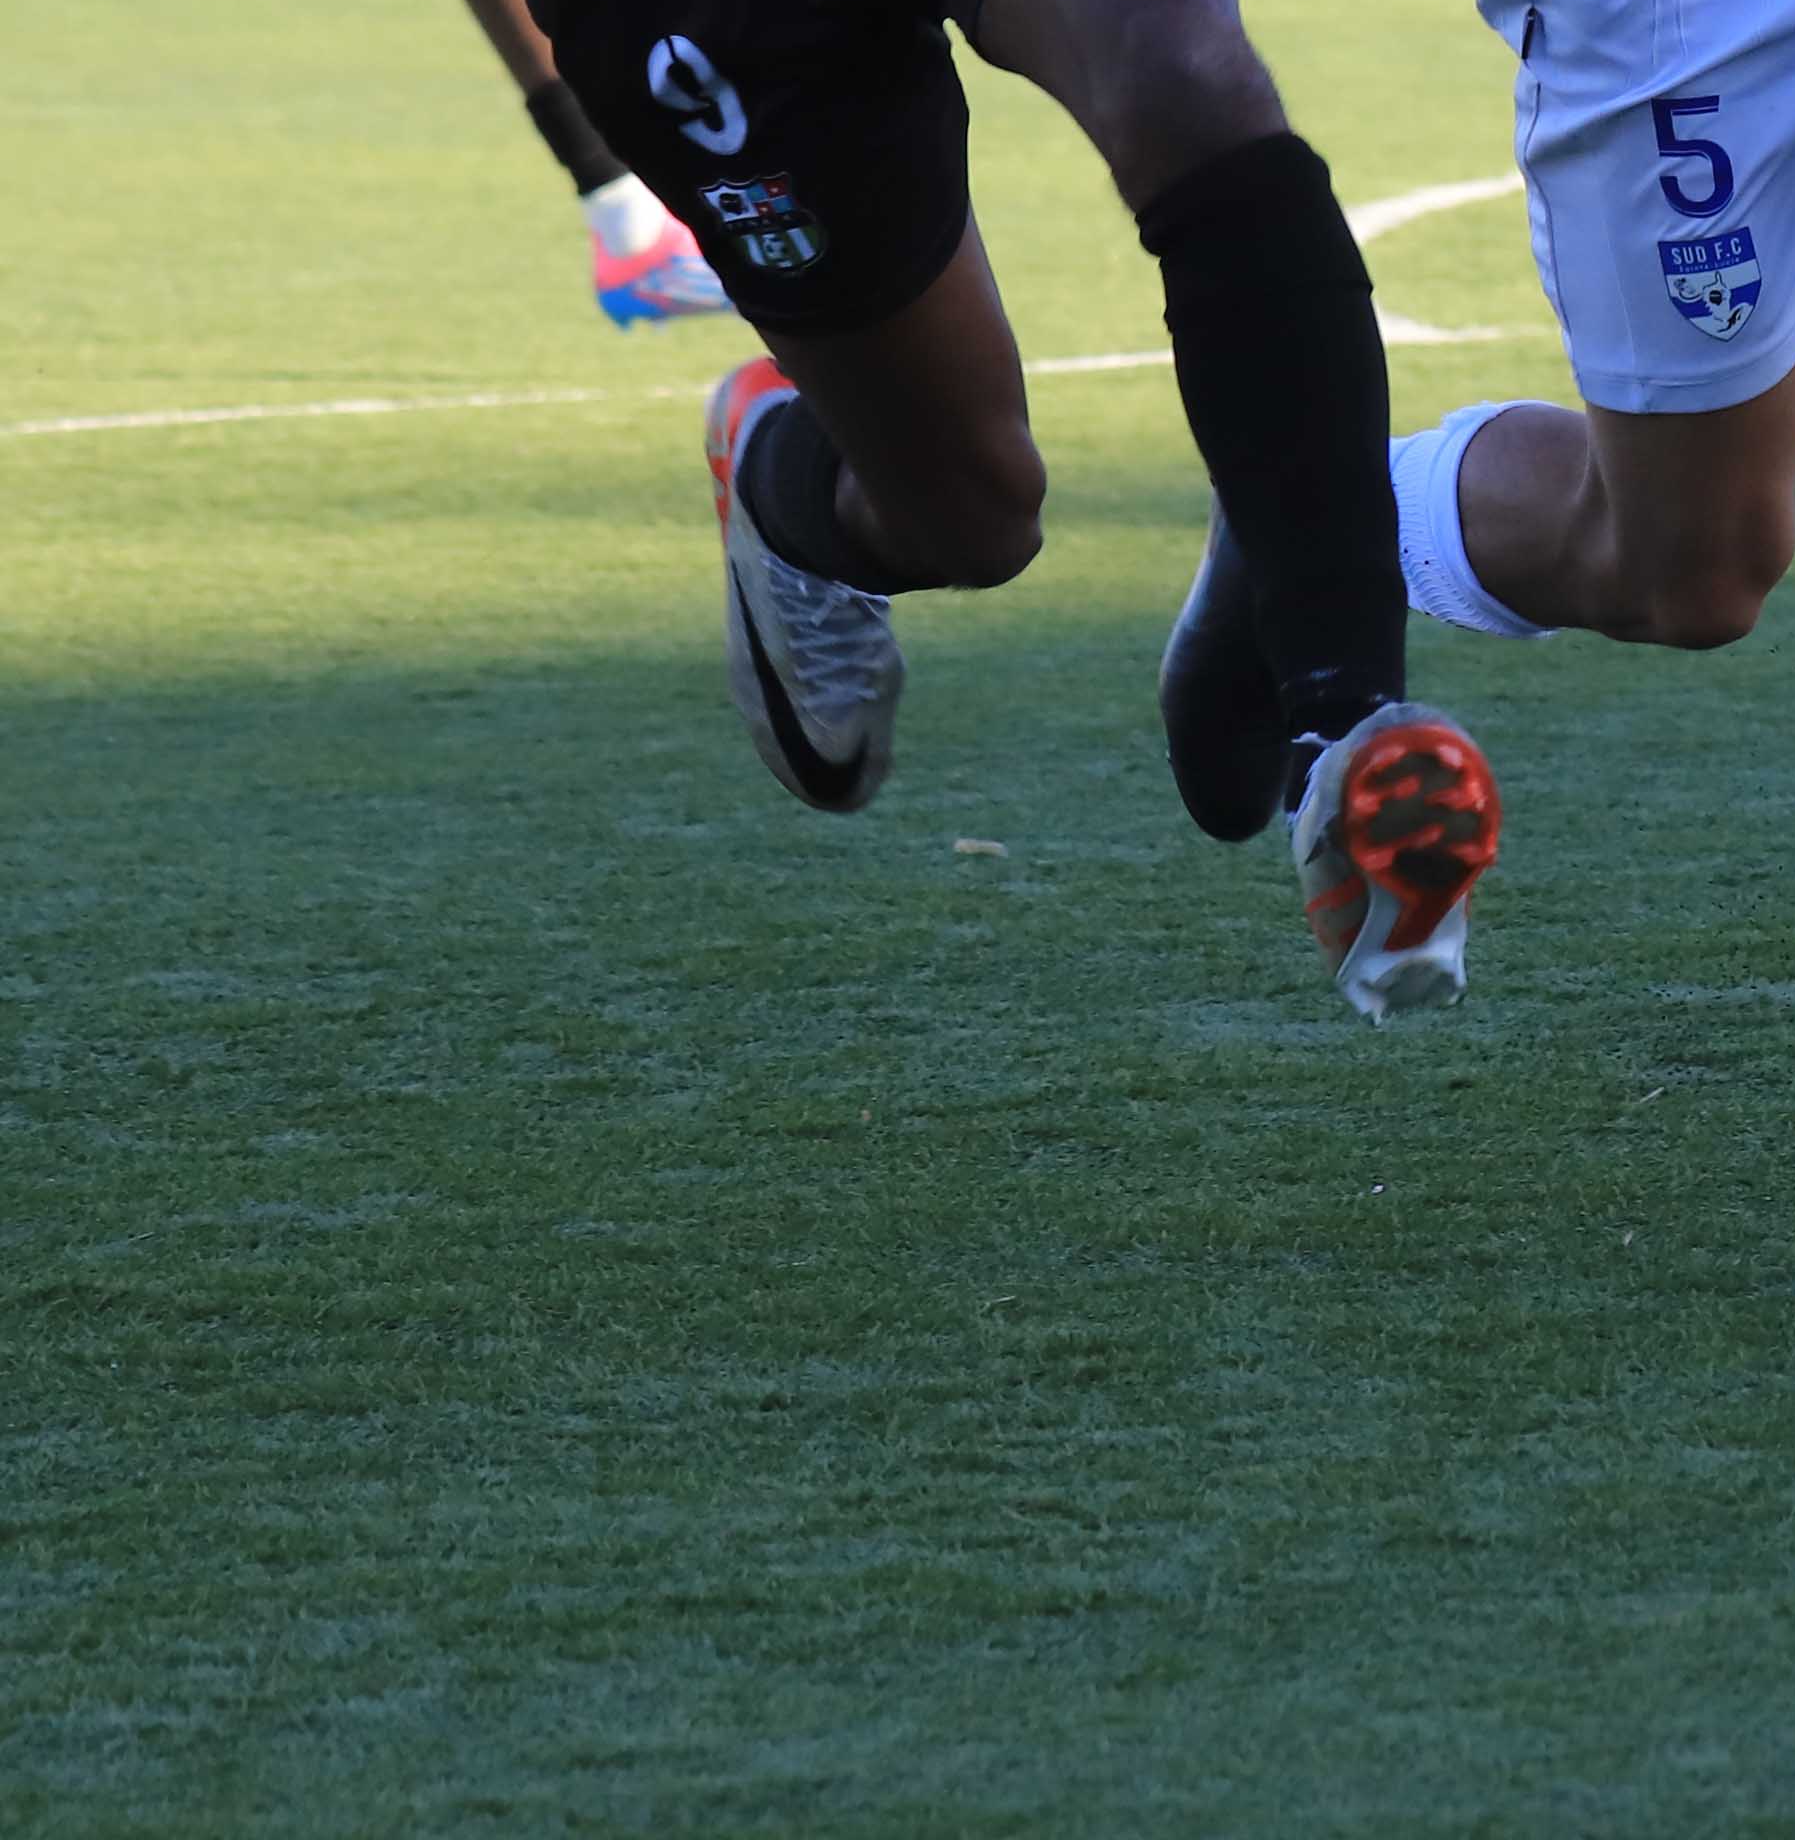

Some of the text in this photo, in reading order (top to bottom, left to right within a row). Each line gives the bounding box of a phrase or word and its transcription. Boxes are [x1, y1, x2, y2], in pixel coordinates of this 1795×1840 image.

[647, 34, 748, 156] 9
[1651, 94, 1735, 219] 5
[1671, 237, 1743, 265] SUD F.C
